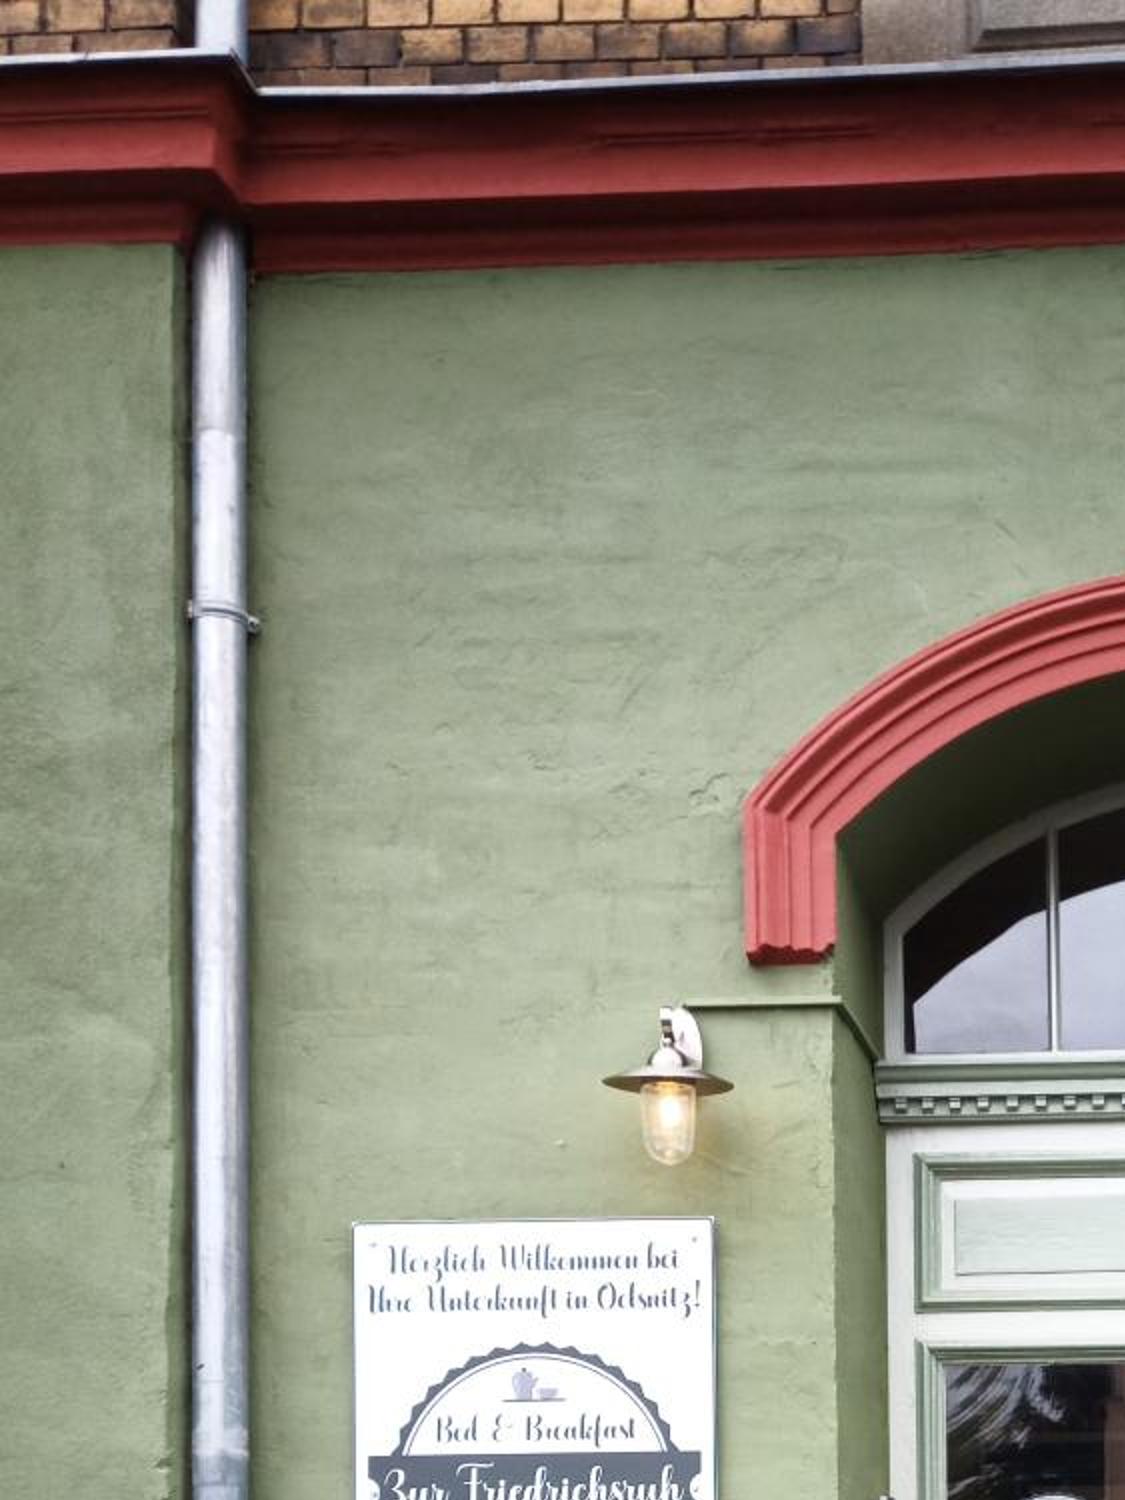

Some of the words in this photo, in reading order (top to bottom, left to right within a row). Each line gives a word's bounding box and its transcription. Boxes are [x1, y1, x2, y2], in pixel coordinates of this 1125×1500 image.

[388, 1245, 486, 1283] Herzlich
[646, 1241, 680, 1269] bei
[368, 1284, 412, 1314] Ihre
[427, 1284, 558, 1319] Unterkunft
[566, 1290, 589, 1310] in
[597, 1279, 702, 1319] Oelsnitz!
[436, 1414, 478, 1443] Bed
[492, 1413, 513, 1442] &
[526, 1414, 636, 1448] Breakfast
